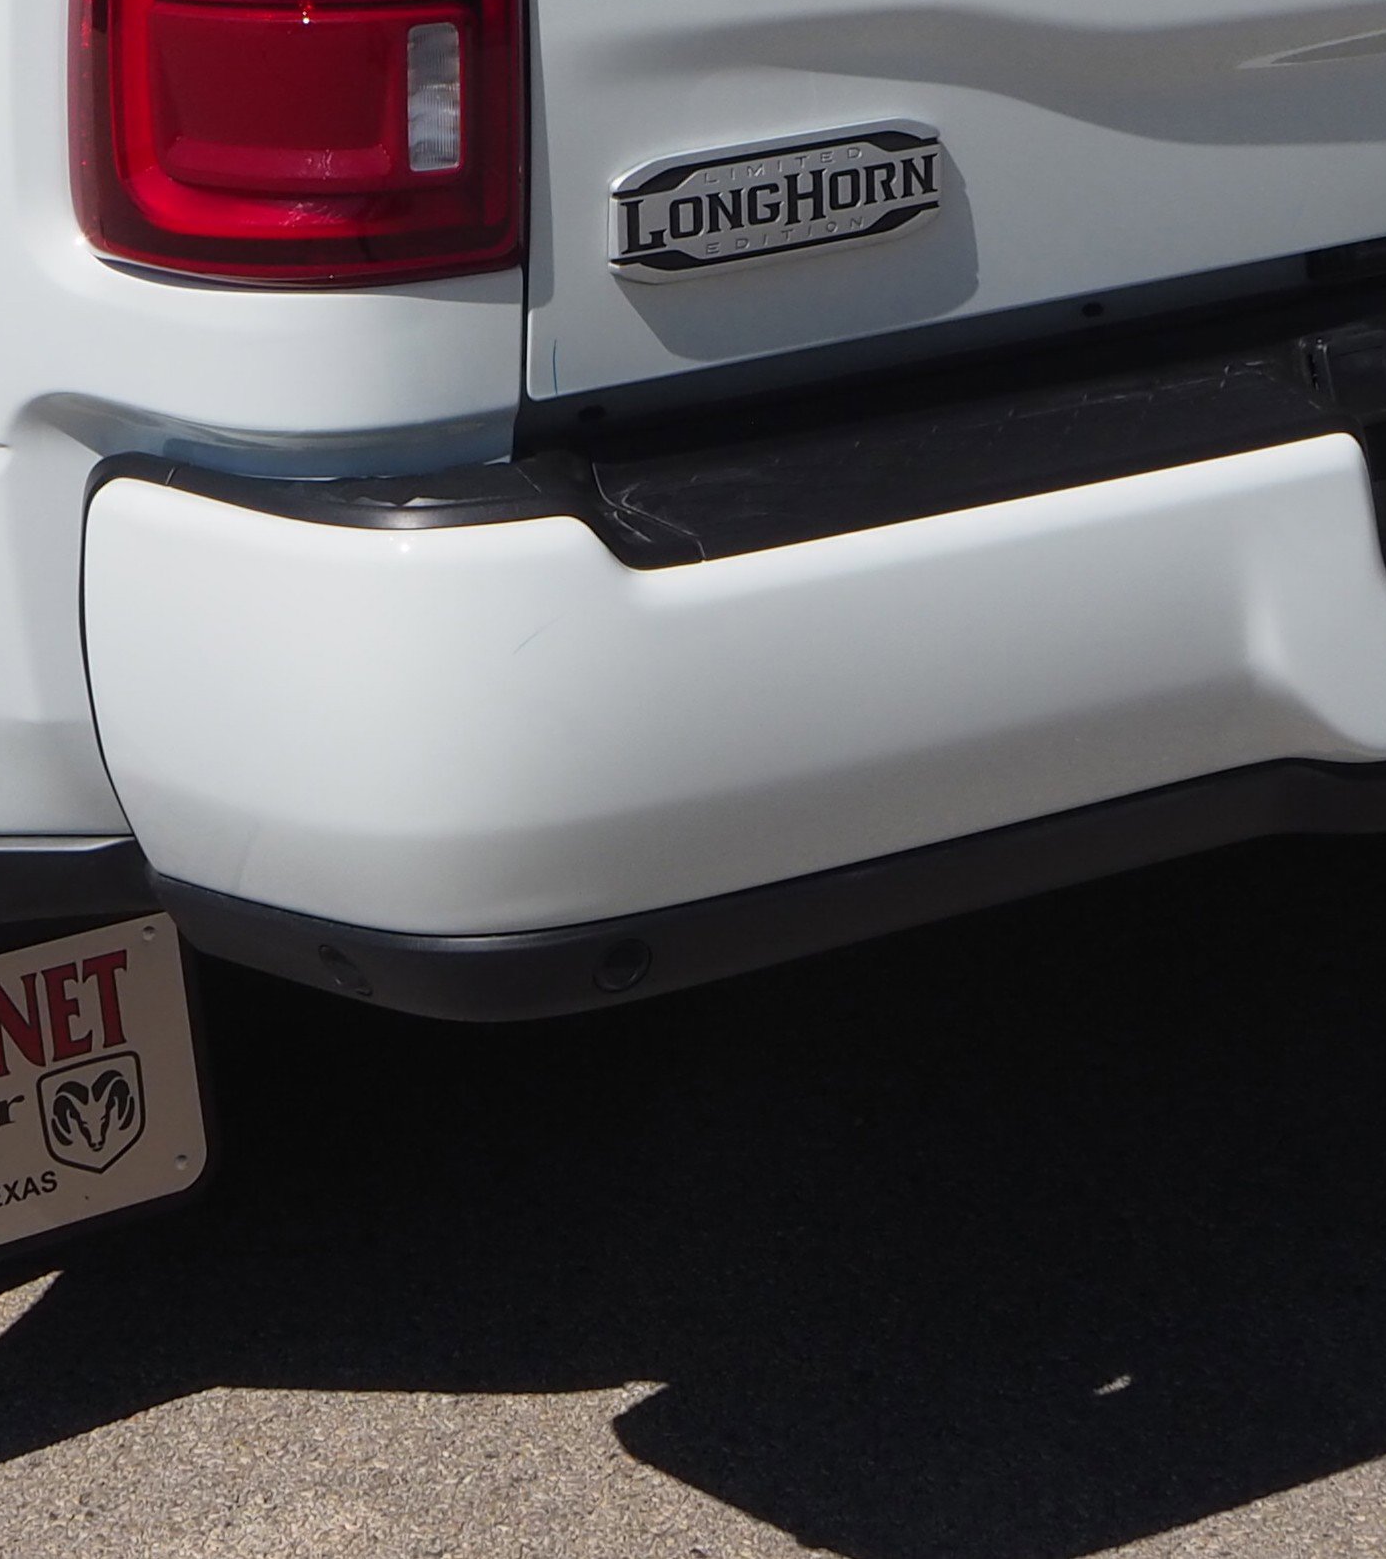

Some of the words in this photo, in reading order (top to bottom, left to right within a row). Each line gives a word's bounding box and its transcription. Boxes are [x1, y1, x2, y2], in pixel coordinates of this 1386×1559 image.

[702, 146, 864, 184] LIMITED
[619, 152, 940, 255] LONGHORN
[704, 216, 864, 255] EDITION
